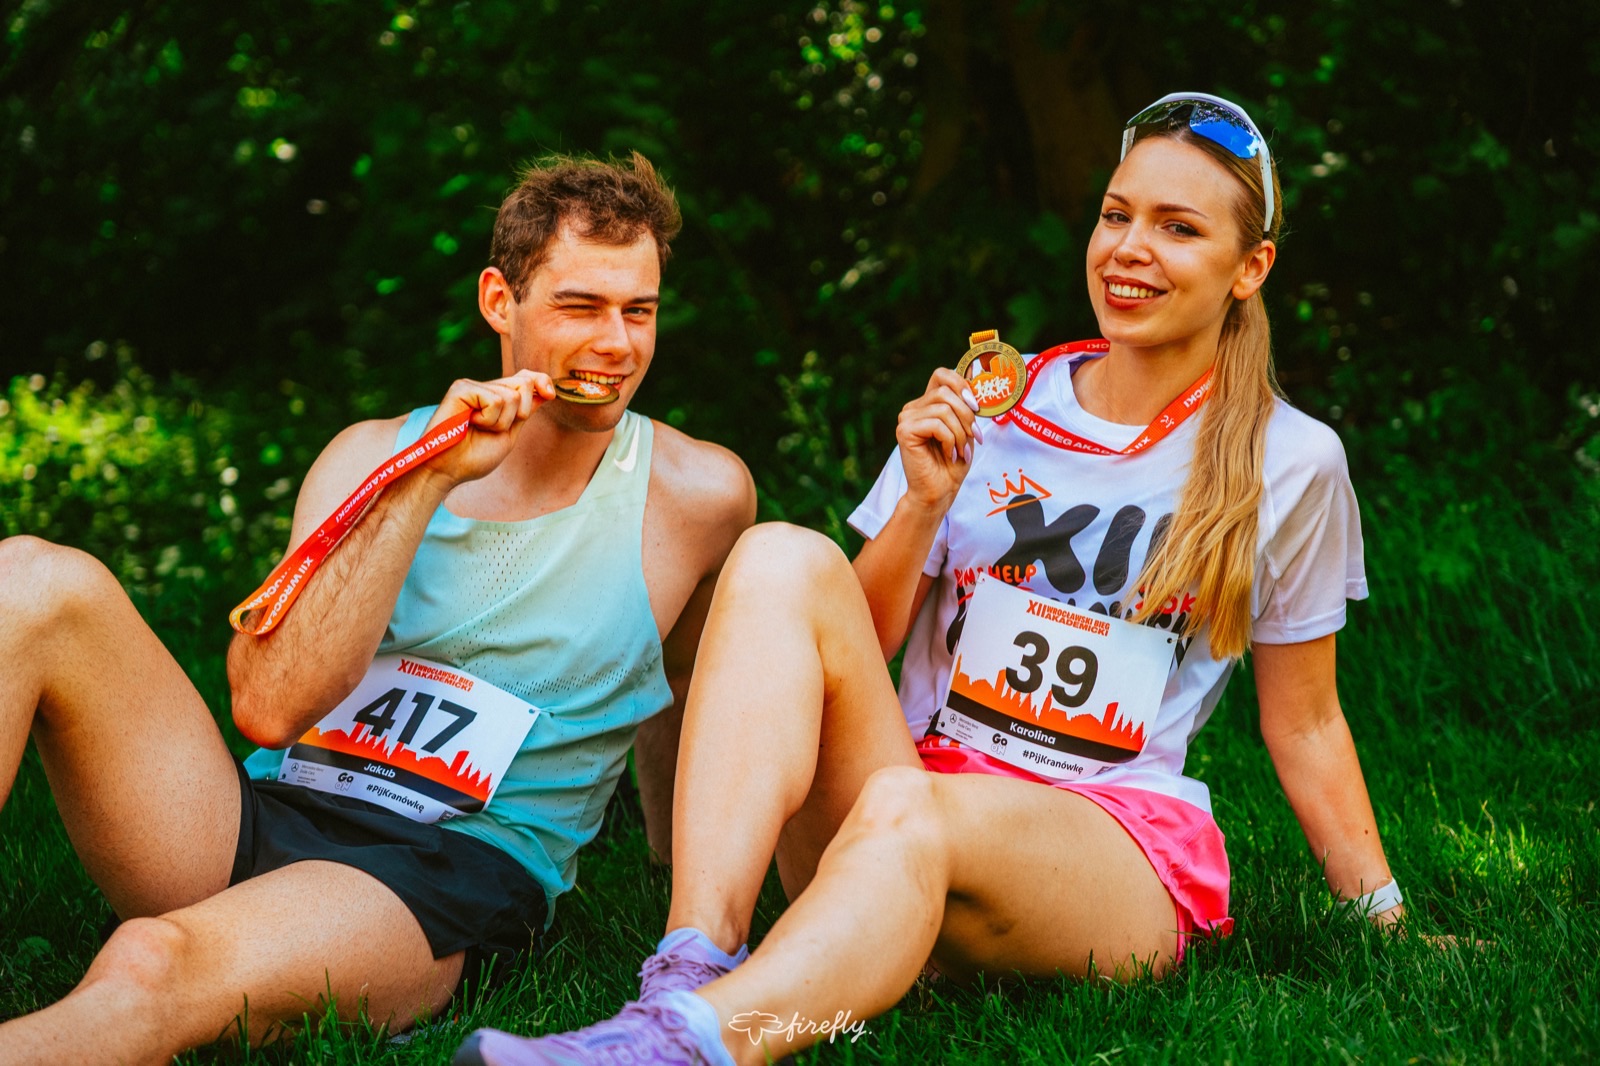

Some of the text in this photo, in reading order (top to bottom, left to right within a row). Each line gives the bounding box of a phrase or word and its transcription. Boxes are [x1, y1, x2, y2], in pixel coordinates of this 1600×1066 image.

[1042, 428, 1073, 446] BIEG
[395, 447, 426, 468] BIEG
[335, 465, 395, 523] AKADEMICKI
[298, 556, 313, 574] XII
[988, 564, 1037, 583] HELP
[1026, 599, 1047, 618] XII
[1046, 605, 1093, 624] WROCŁAWSKI
[1093, 619, 1111, 631] BIEG
[1044, 613, 1109, 637] AKADEMICKI
[397, 659, 418, 676] XII
[417, 664, 459, 681] WROCŁAWSKI
[415, 670, 472, 692] AKADEMICKI
[1005, 630, 1099, 709] 39
[352, 687, 478, 754] 417
[1009, 722, 1056, 745] Karolina
[363, 763, 396, 778] Jakub
[1022, 750, 1084, 775] #PijKranówkę
[366, 784, 425, 814] #PijKranówkę
